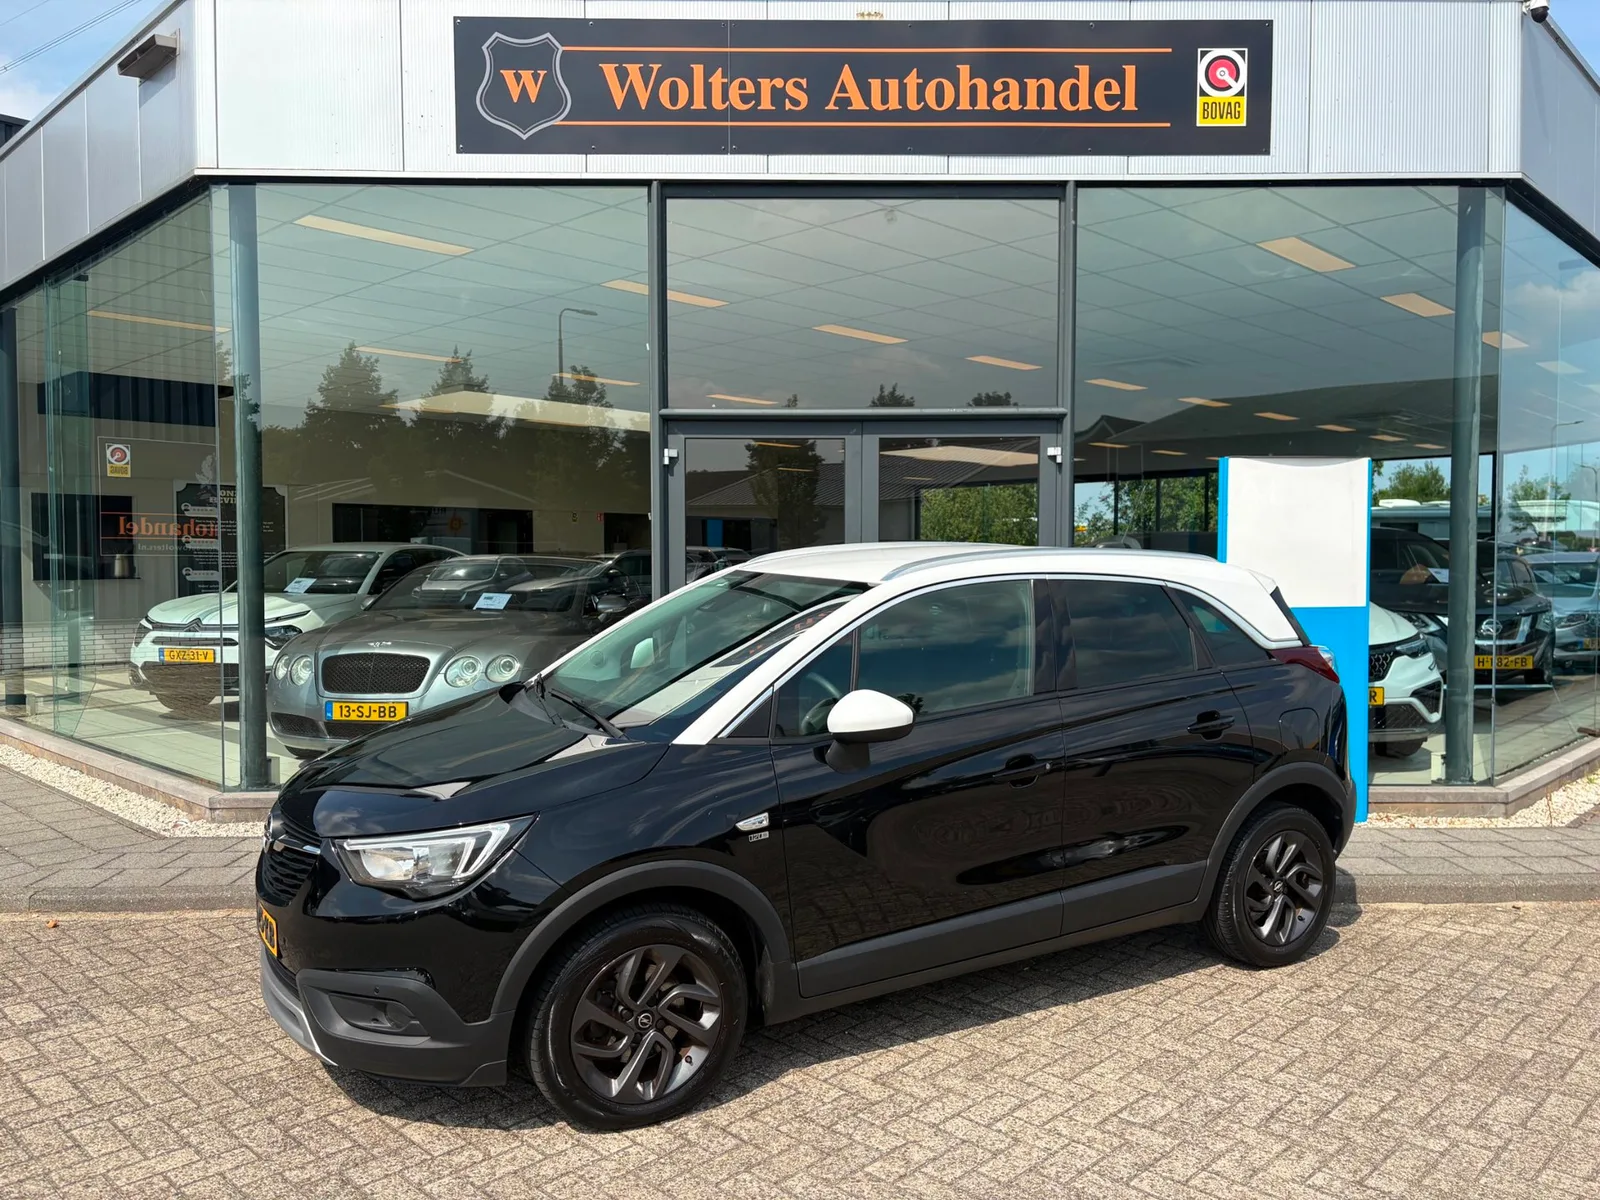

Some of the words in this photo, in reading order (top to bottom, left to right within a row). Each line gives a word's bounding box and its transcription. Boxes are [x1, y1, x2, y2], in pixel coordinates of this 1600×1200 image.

[500, 69, 547, 103] W
[598, 63, 809, 111] Wolters
[824, 63, 1139, 112] Autohandel
[1202, 101, 1241, 120] BOVAG
[169, 650, 209, 661] GXZ-31-V
[339, 704, 397, 719] 13-SJ-BB
